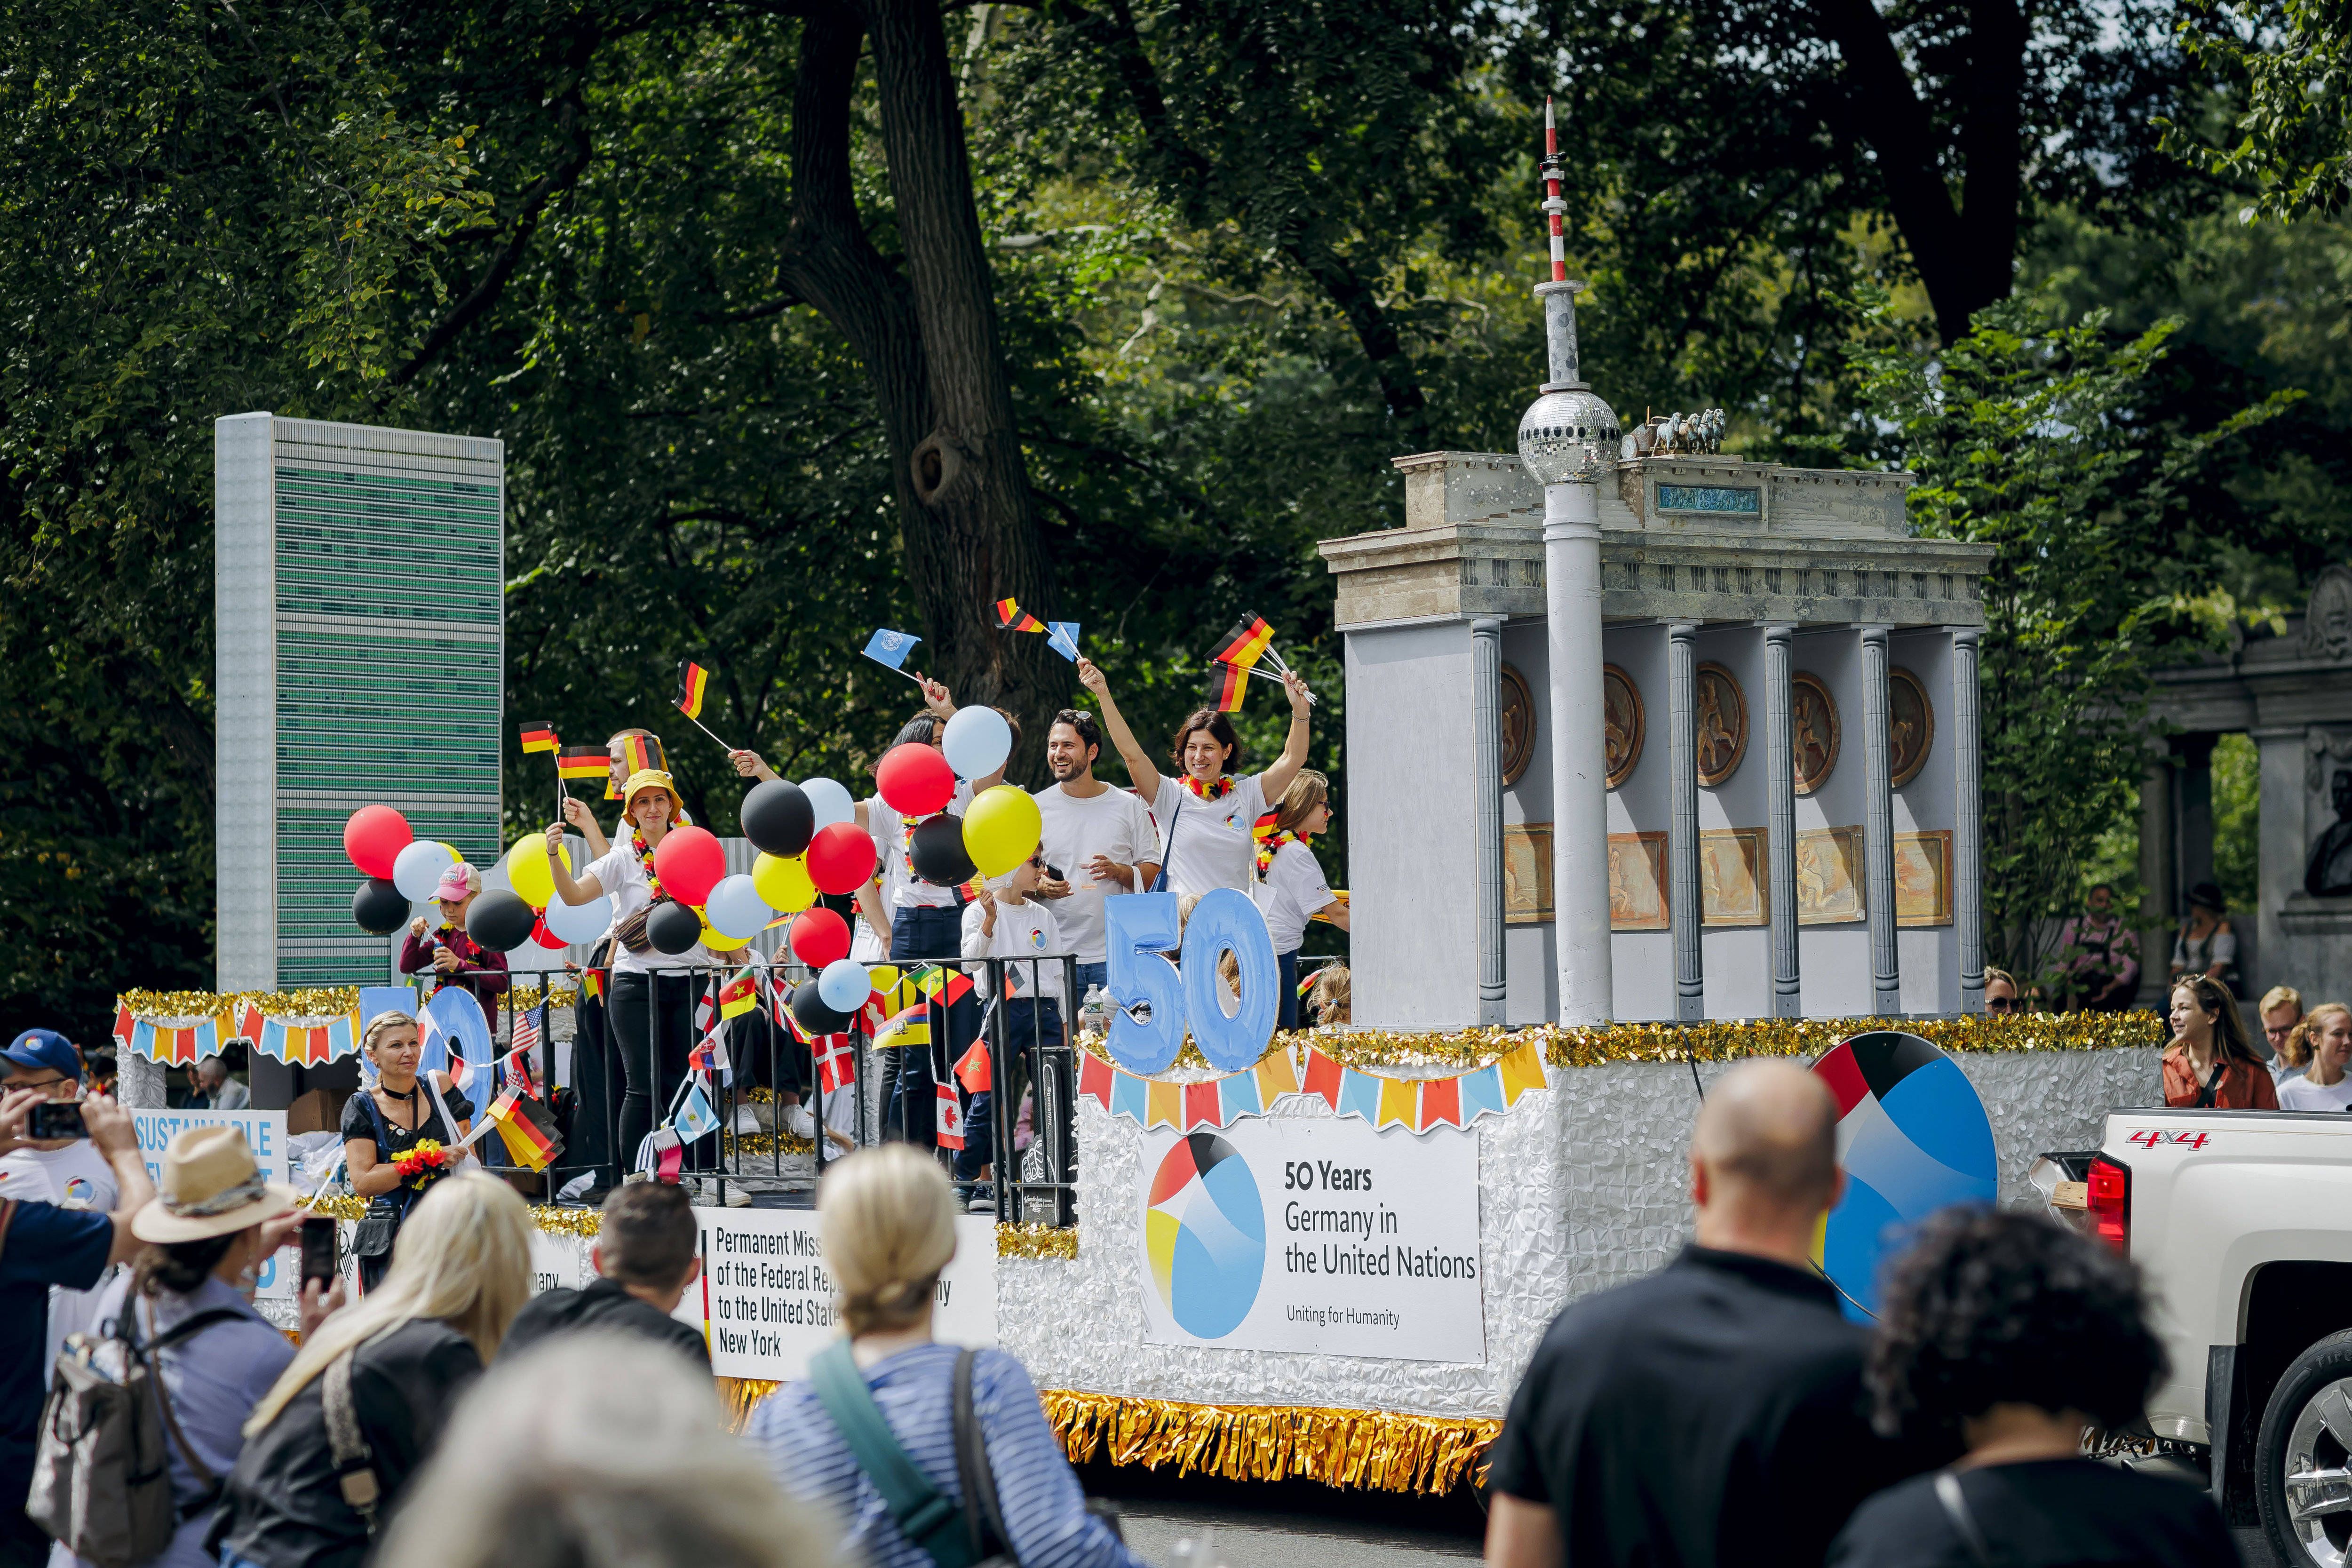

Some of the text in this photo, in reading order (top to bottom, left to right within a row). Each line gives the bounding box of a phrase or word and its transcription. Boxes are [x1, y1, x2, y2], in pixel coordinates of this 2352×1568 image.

[1104, 887, 1280, 1075] 50
[135, 1115, 272, 1156] SUSTLE
[1285, 1160, 1372, 1191] 50 Years
[1285, 1201, 1398, 1242] Germany in
[716, 1226, 823, 1258] Permanent Miss
[717, 1261, 730, 1286] of
[734, 1261, 757, 1288] the
[761, 1262, 809, 1291] Federal
[1285, 1242, 1475, 1279] the United Nations
[718, 1295, 840, 1327] to the United State
[1287, 1305, 1399, 1330] Uniting for Humanity
[719, 1327, 781, 1357] New York
